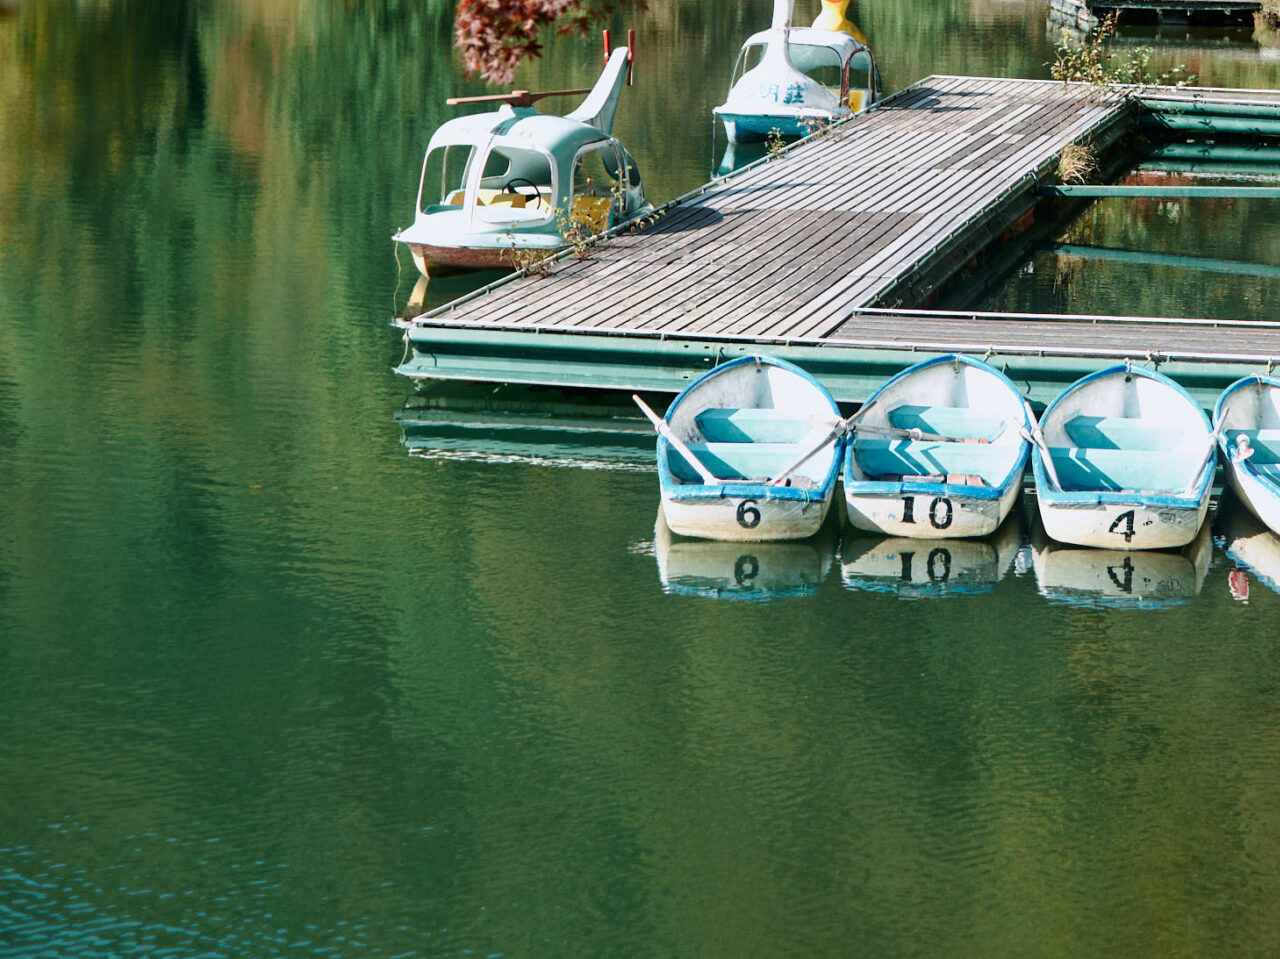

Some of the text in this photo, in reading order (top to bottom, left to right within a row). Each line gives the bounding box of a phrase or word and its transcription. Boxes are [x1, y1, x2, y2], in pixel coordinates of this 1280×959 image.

[736, 498, 761, 529] 6
[901, 496, 953, 529] 10
[1108, 509, 1136, 543] 4
